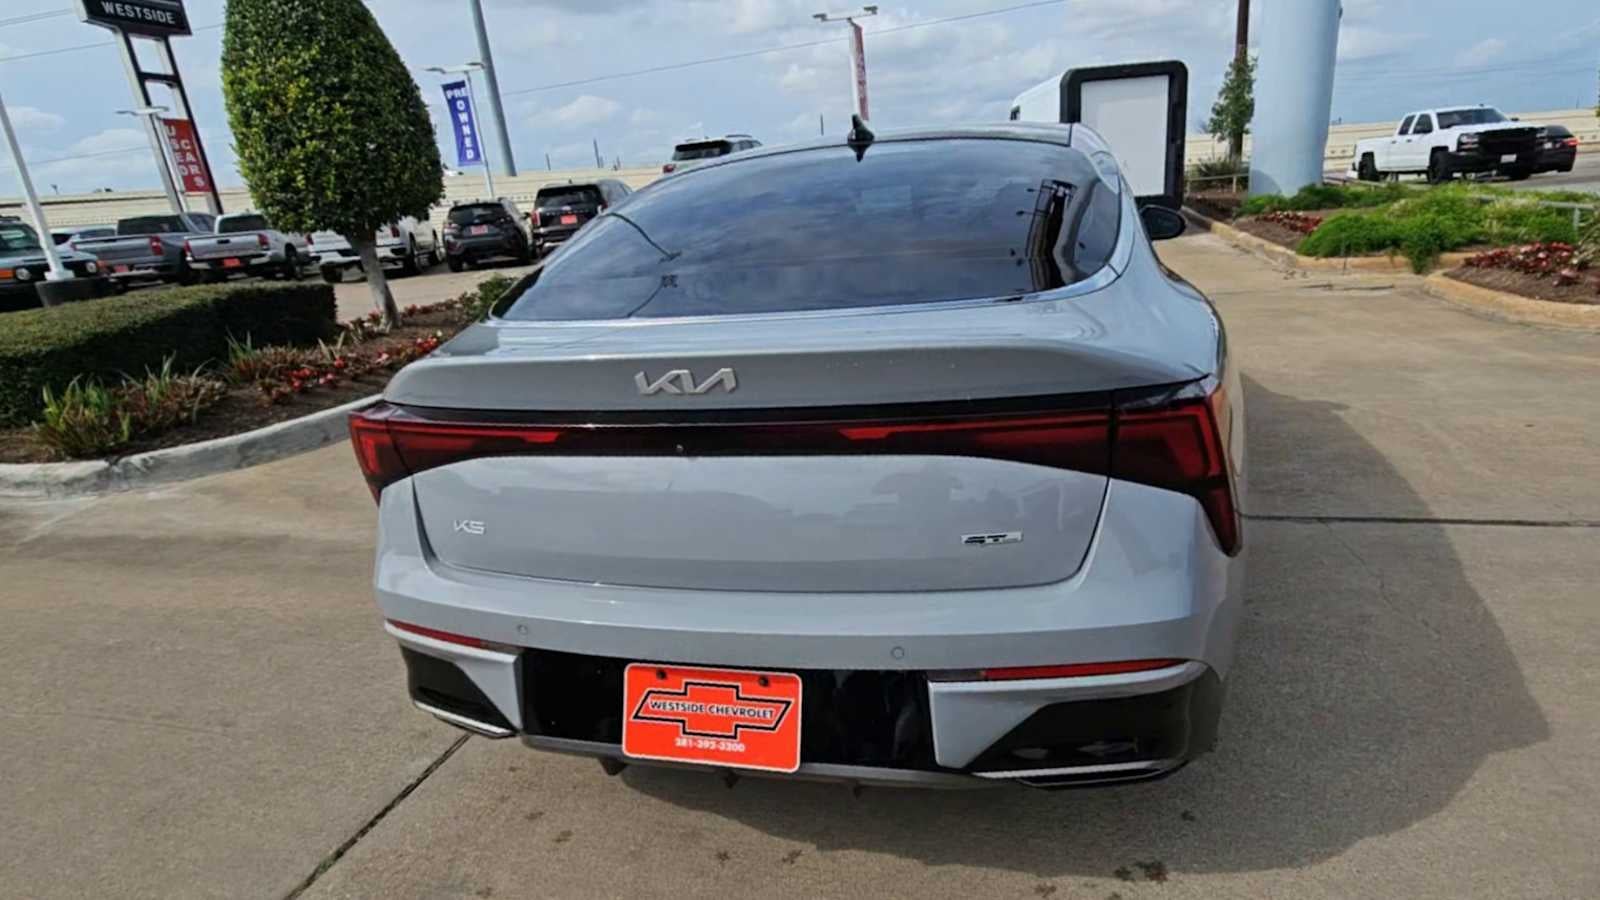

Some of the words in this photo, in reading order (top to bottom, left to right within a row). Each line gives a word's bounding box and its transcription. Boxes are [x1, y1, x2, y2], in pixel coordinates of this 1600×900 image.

[101, 1, 176, 24] WESTSIDE
[446, 87, 467, 99] PRE
[456, 99, 474, 160] OWNED
[165, 125, 188, 176] USED
[180, 139, 205, 187] CARS
[634, 367, 737, 395] KIA
[453, 519, 485, 535] K5
[650, 700, 705, 713] WESTSIDE
[708, 704, 774, 719] CHEVROLET
